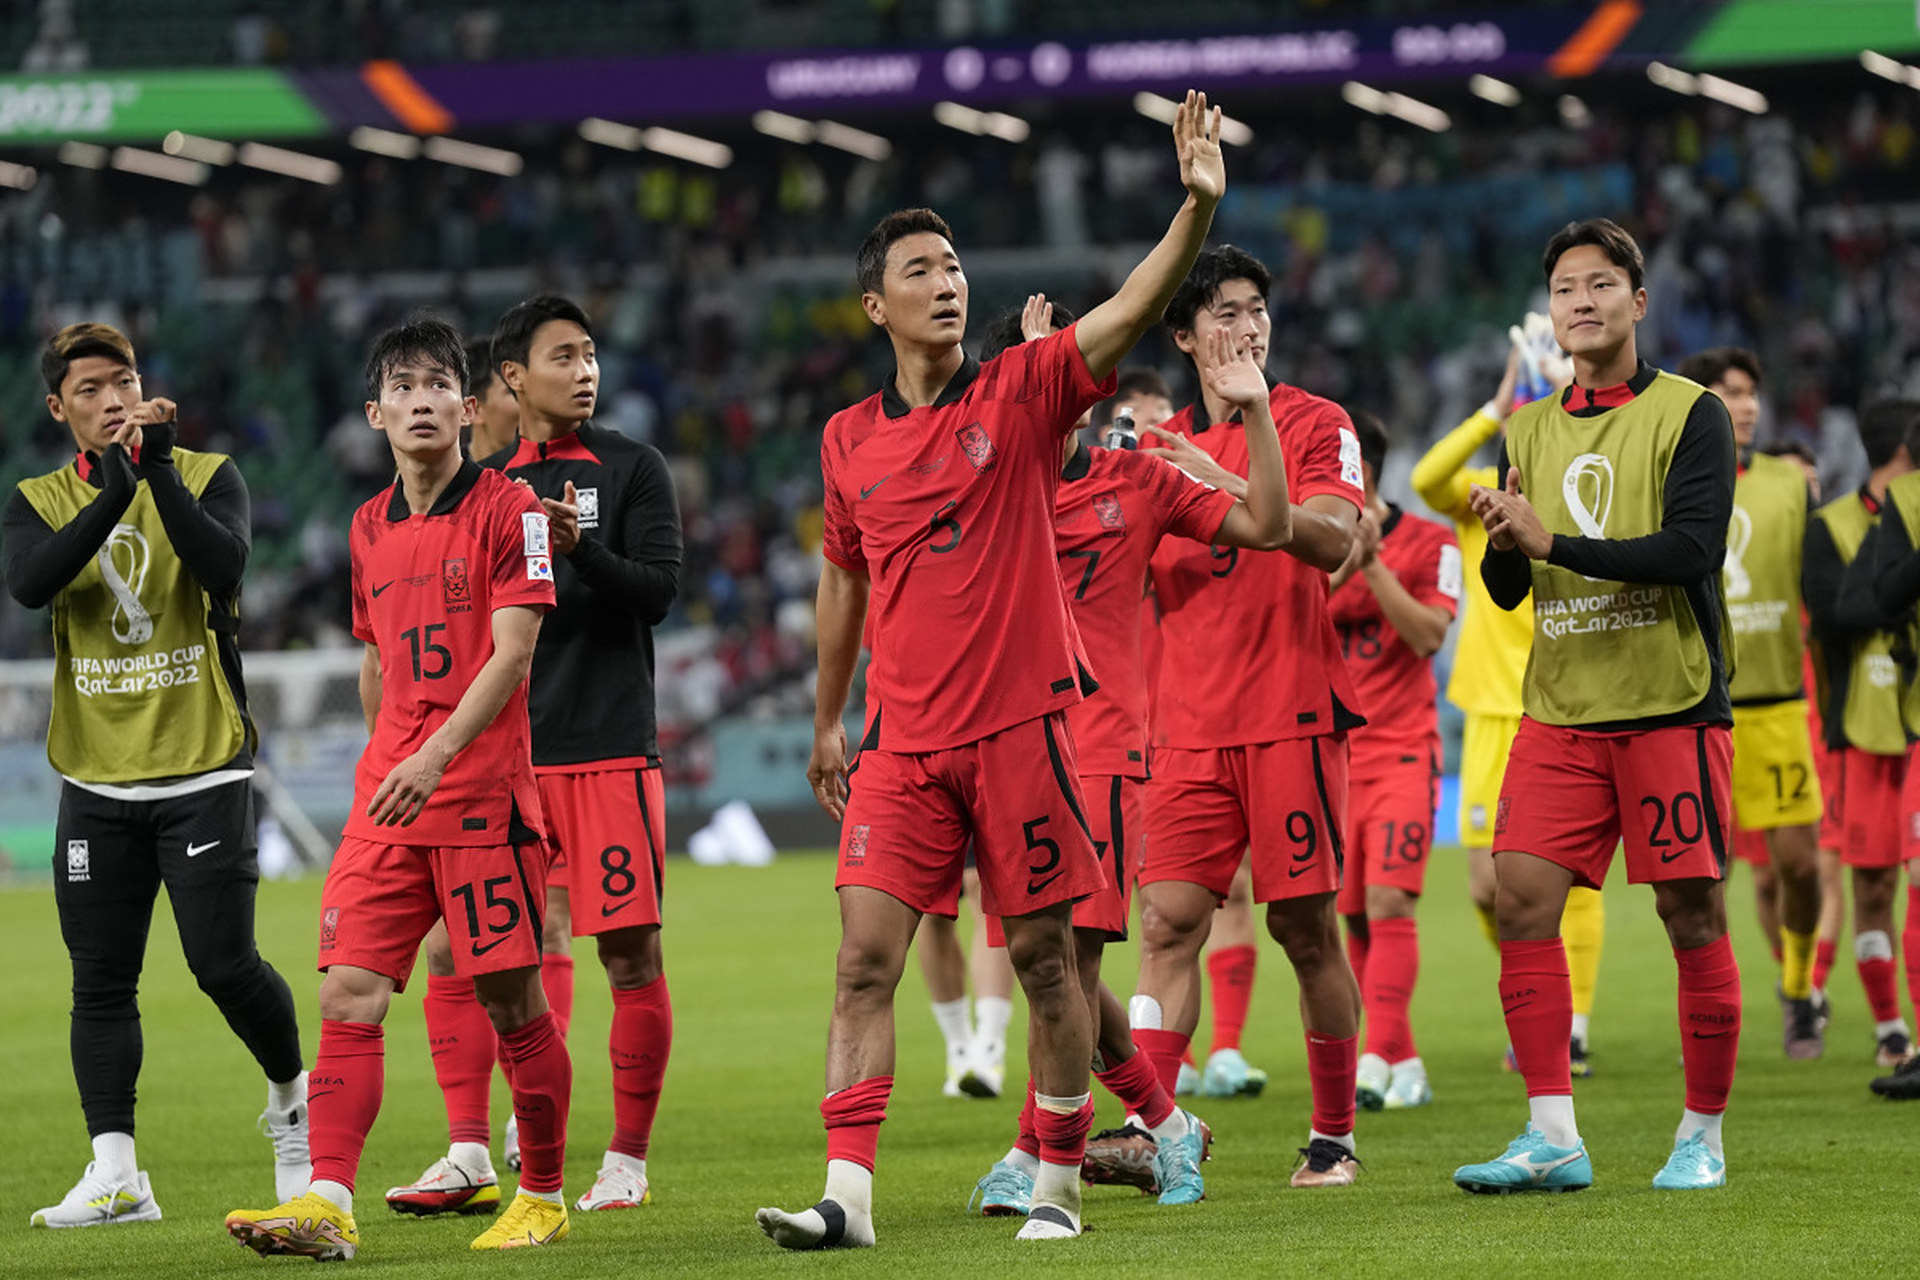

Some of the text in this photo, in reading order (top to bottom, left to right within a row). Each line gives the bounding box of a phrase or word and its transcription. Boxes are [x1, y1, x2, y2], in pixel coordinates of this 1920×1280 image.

[929, 499, 962, 554] 5
[1068, 550, 1102, 601] 7
[1537, 588, 1663, 617] FIFA WORLD CUP
[70, 644, 206, 674] FIFA WORLD CUP
[400, 623, 453, 683] 15
[1335, 617, 1383, 661] 18
[1767, 761, 1811, 802] 12
[1022, 815, 1061, 875] 5
[1285, 810, 1317, 862] 9
[1381, 820, 1425, 863] 18
[1640, 791, 1704, 847] 20
[600, 845, 636, 897] 8
[451, 875, 521, 938] 15
